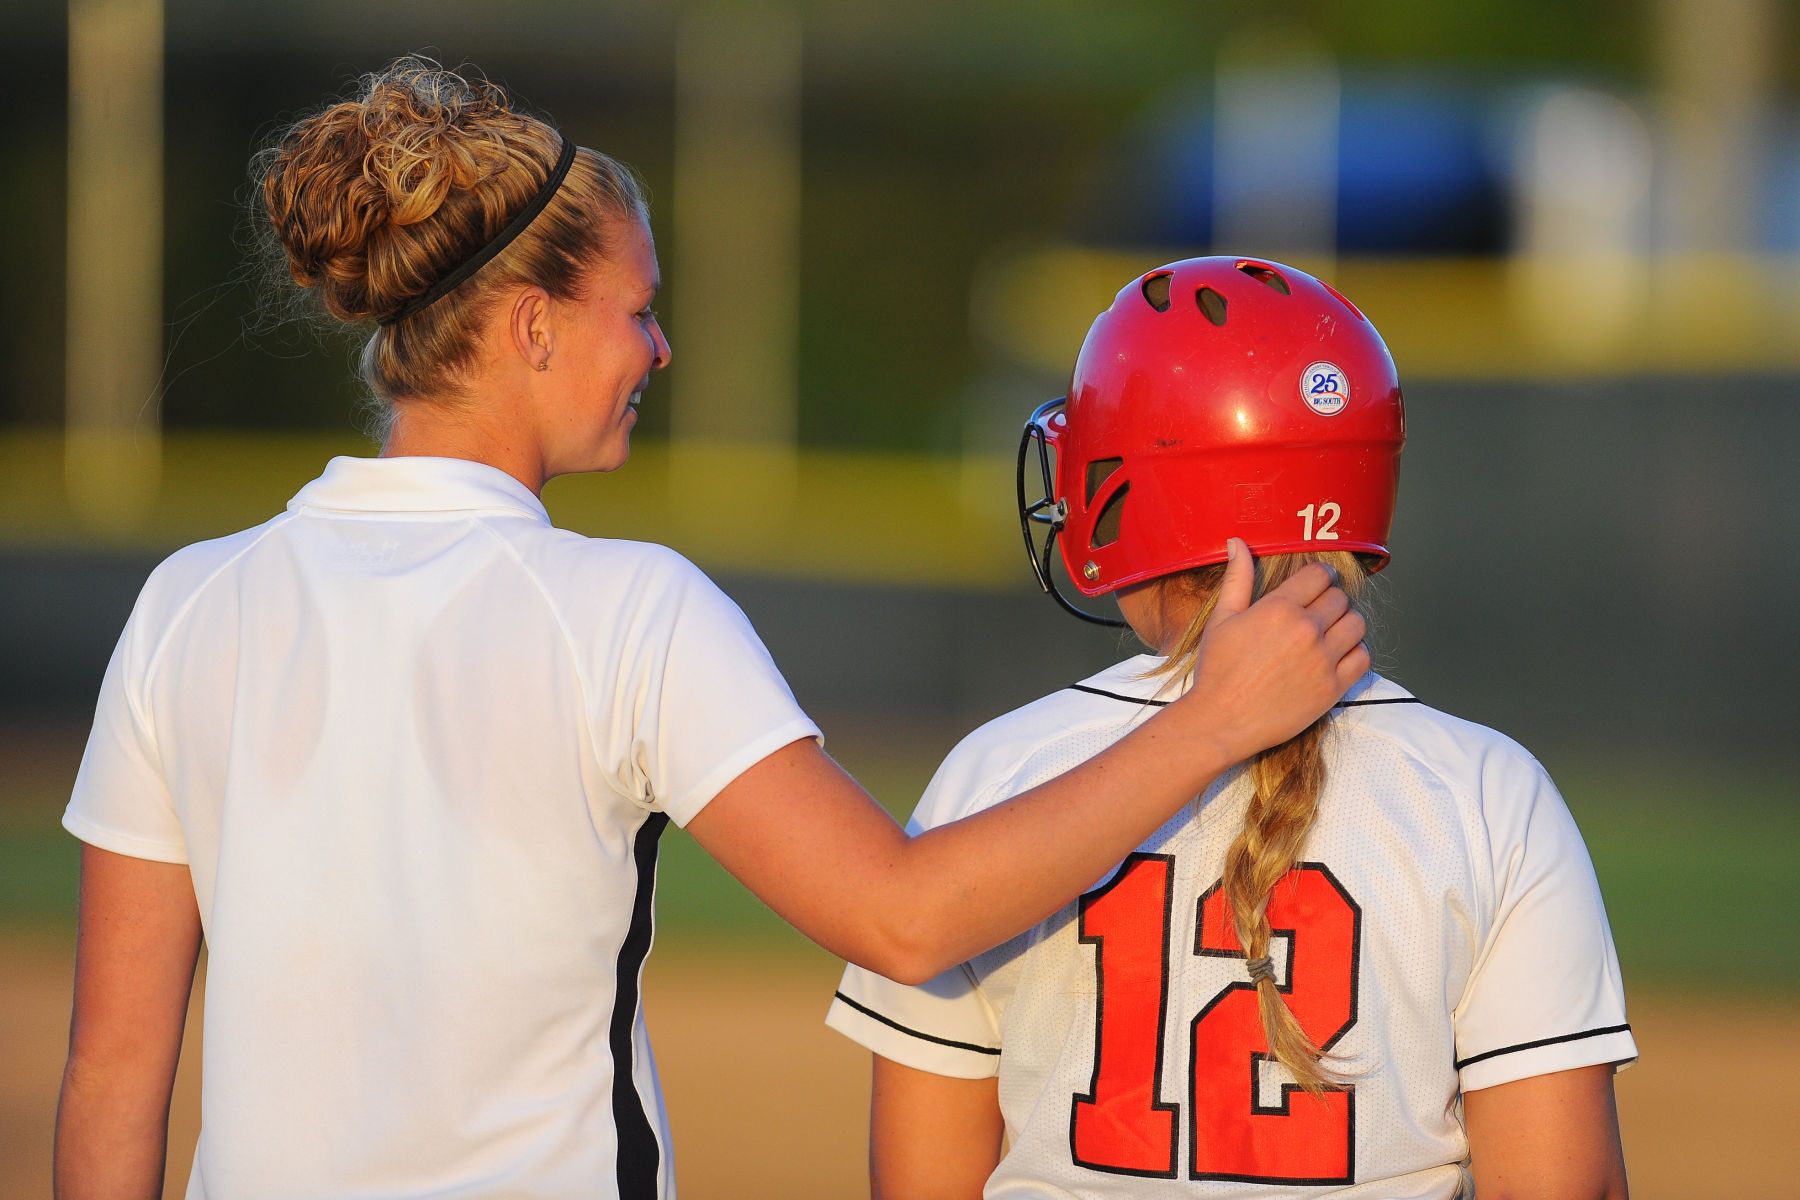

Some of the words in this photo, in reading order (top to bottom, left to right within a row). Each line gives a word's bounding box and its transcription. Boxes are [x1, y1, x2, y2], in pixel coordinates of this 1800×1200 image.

[1311, 373, 1338, 394] 25
[1322, 397, 1341, 405] SOUTH
[1296, 502, 1341, 541] 12
[1069, 852, 1362, 1186] 12
